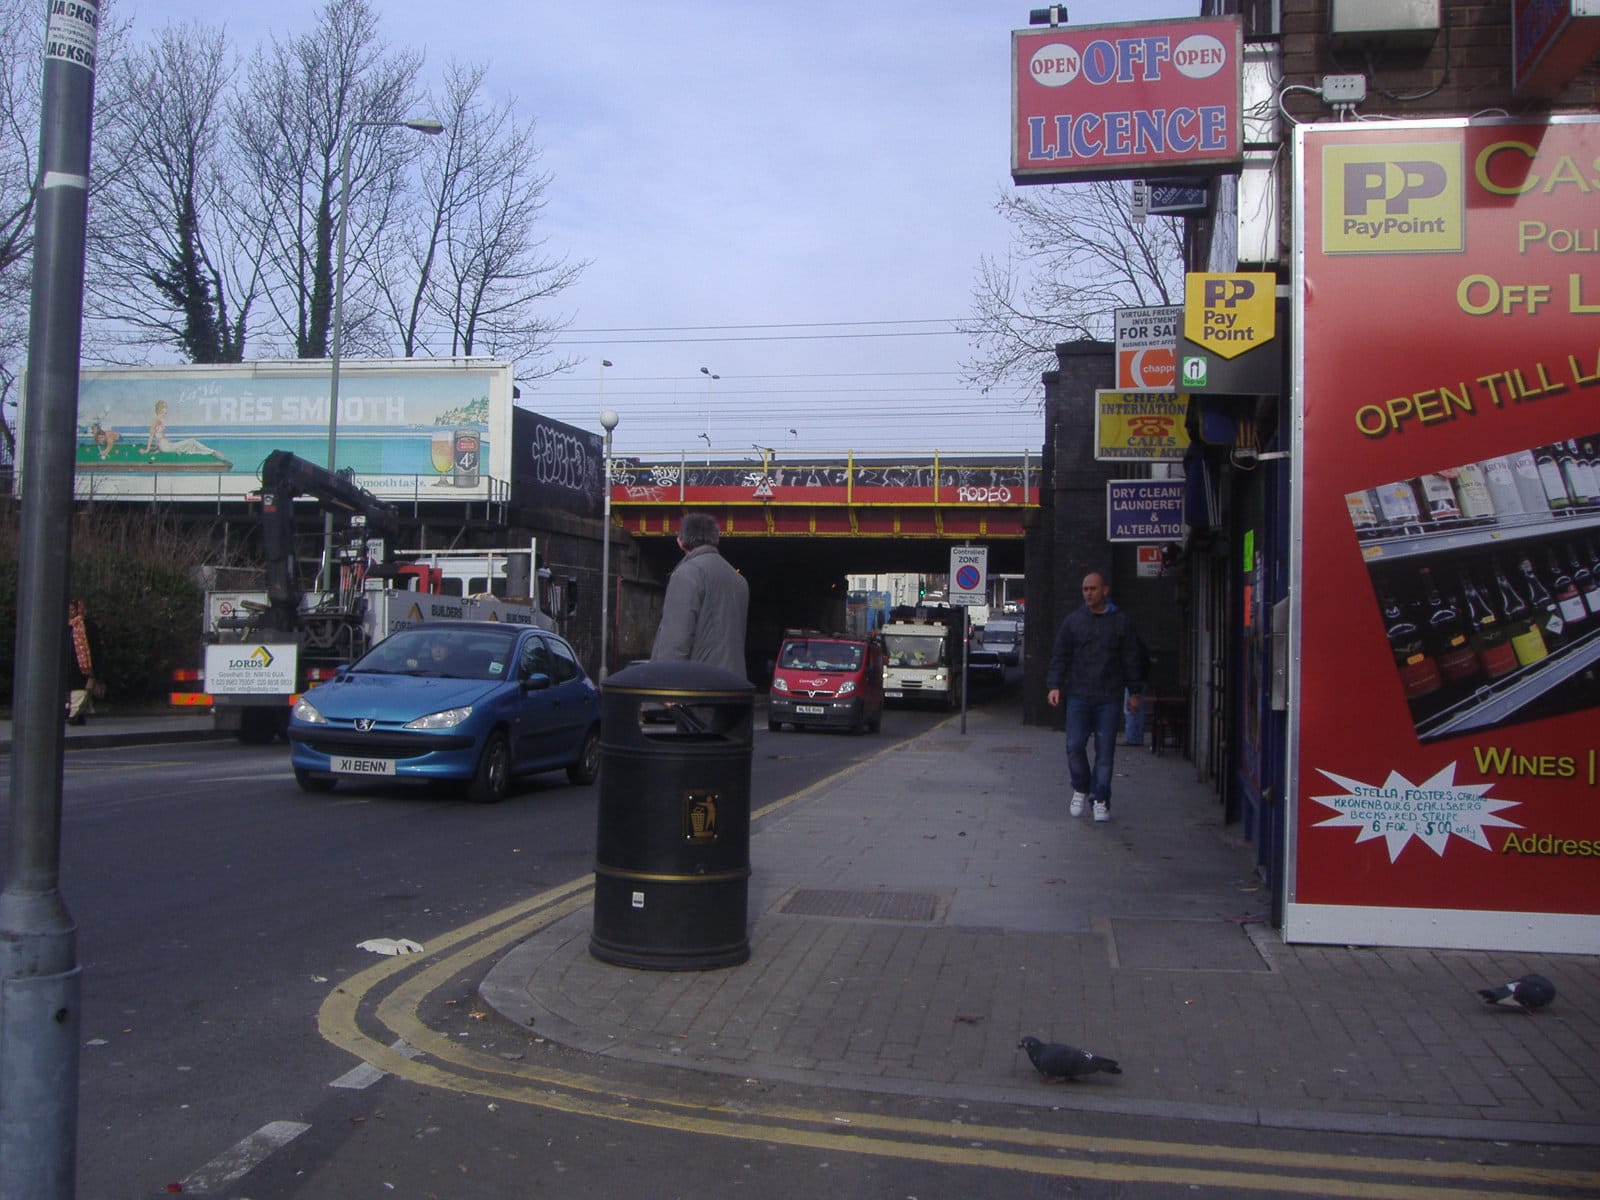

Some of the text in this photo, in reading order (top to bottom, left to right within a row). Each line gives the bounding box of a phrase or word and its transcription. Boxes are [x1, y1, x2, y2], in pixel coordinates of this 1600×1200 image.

[1031, 36, 1222, 85] OPEN OFF OPEN
[1028, 105, 1227, 161] LICENCE
[1474, 140, 1600, 196] CA
[1343, 216, 1446, 239] PayPoint
[1121, 310, 1151, 319] VIRTUAL
[1203, 310, 1237, 328] Pay
[1120, 326, 1148, 340] FOR
[1203, 326, 1255, 341] Point
[1122, 340, 1147, 348] BUSINESS
[1123, 392, 1178, 403] CHEAP
[1355, 348, 1600, 435] OPEN TILL L
[280, 395, 404, 423] SMOOTH
[1127, 436, 1177, 447] CALLS
[400, 477, 427, 488] tase.
[957, 485, 1011, 503] RODEO
[1112, 488, 1136, 498] DRY
[1150, 511, 1159, 522] &
[952, 548, 985, 556] Controlled
[431, 604, 463, 619] BUILDERS
[229, 659, 263, 668] LORDS
[353, 760, 387, 773] BENN
[1473, 746, 1575, 777] WINES
[1394, 811, 1417, 821] RED
[1372, 821, 1381, 833] 6
[1386, 822, 1408, 832] FOR
[1455, 824, 1476, 839] only
